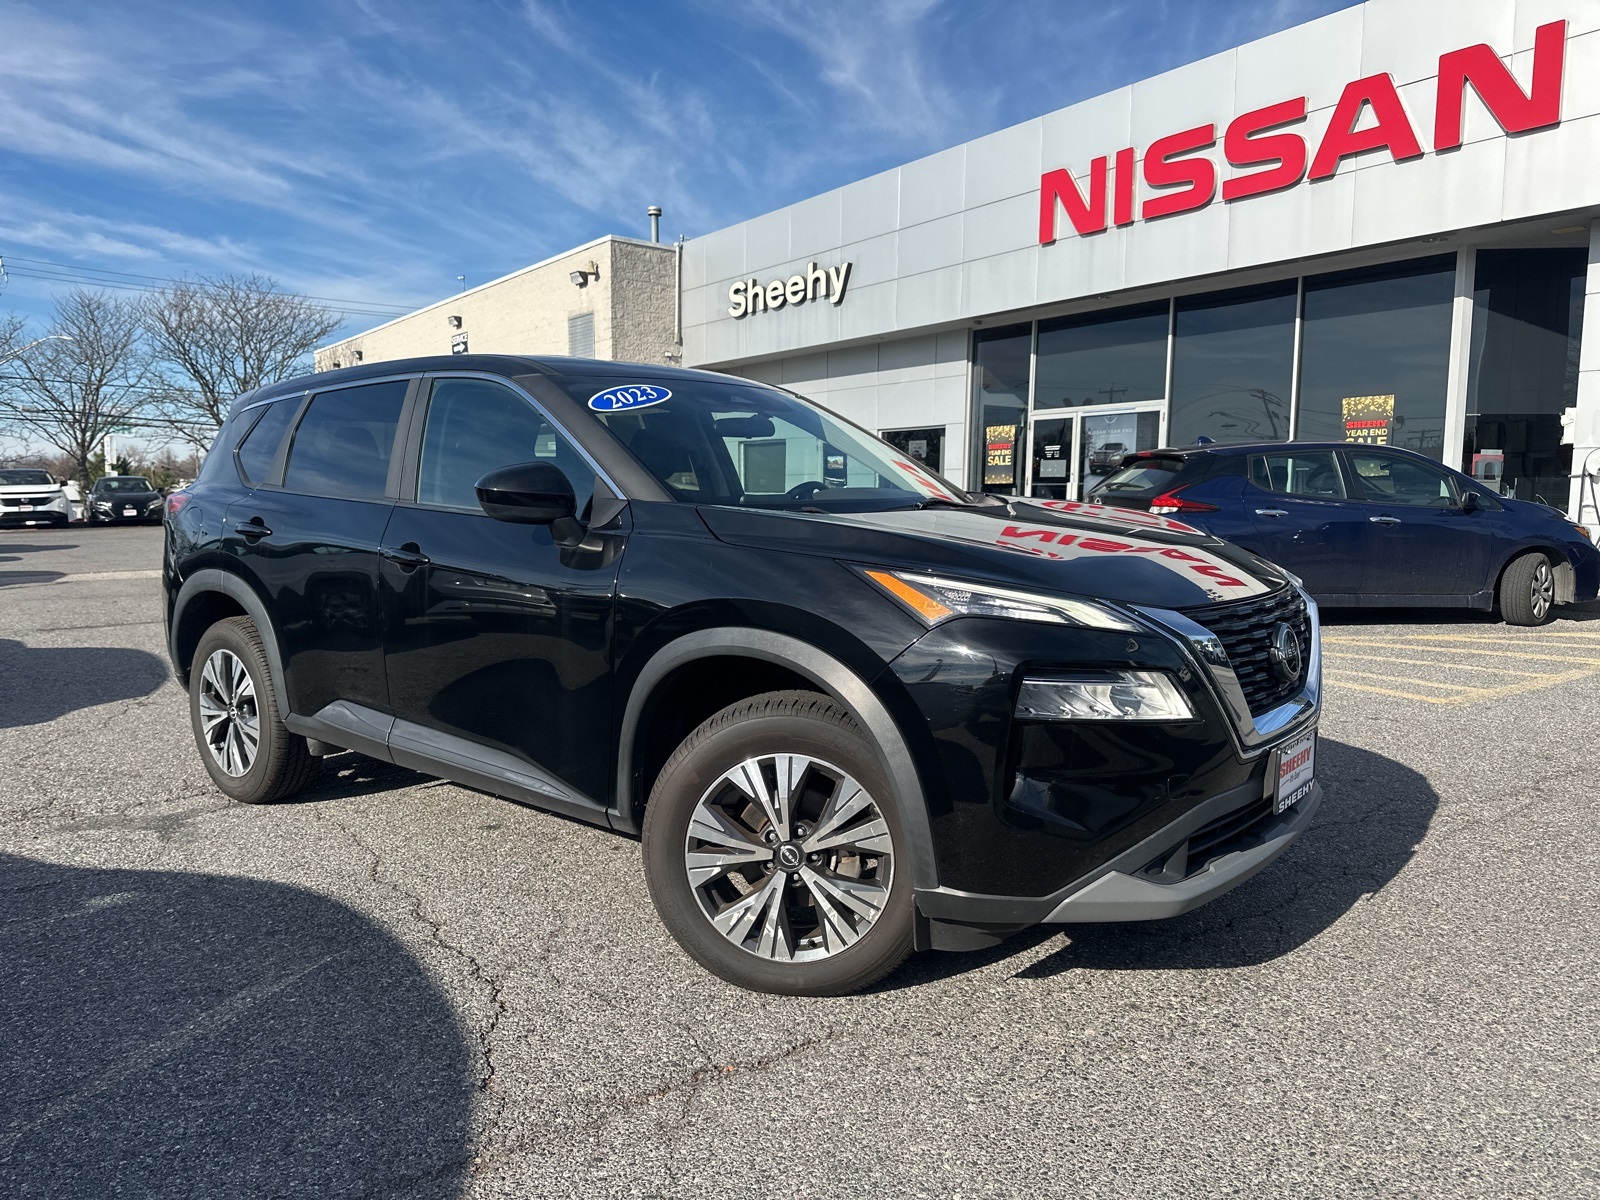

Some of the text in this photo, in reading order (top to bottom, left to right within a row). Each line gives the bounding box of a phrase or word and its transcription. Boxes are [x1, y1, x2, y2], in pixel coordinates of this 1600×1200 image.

[1039, 18, 1568, 245] NISSAN
[728, 262, 850, 318] Sheehy
[604, 386, 657, 408] 2023
[1346, 420, 1387, 428] SHEEHY
[988, 456, 1011, 466] SALE
[1279, 746, 1312, 779] SHEEHY
[1279, 779, 1314, 813] SHEEHY
